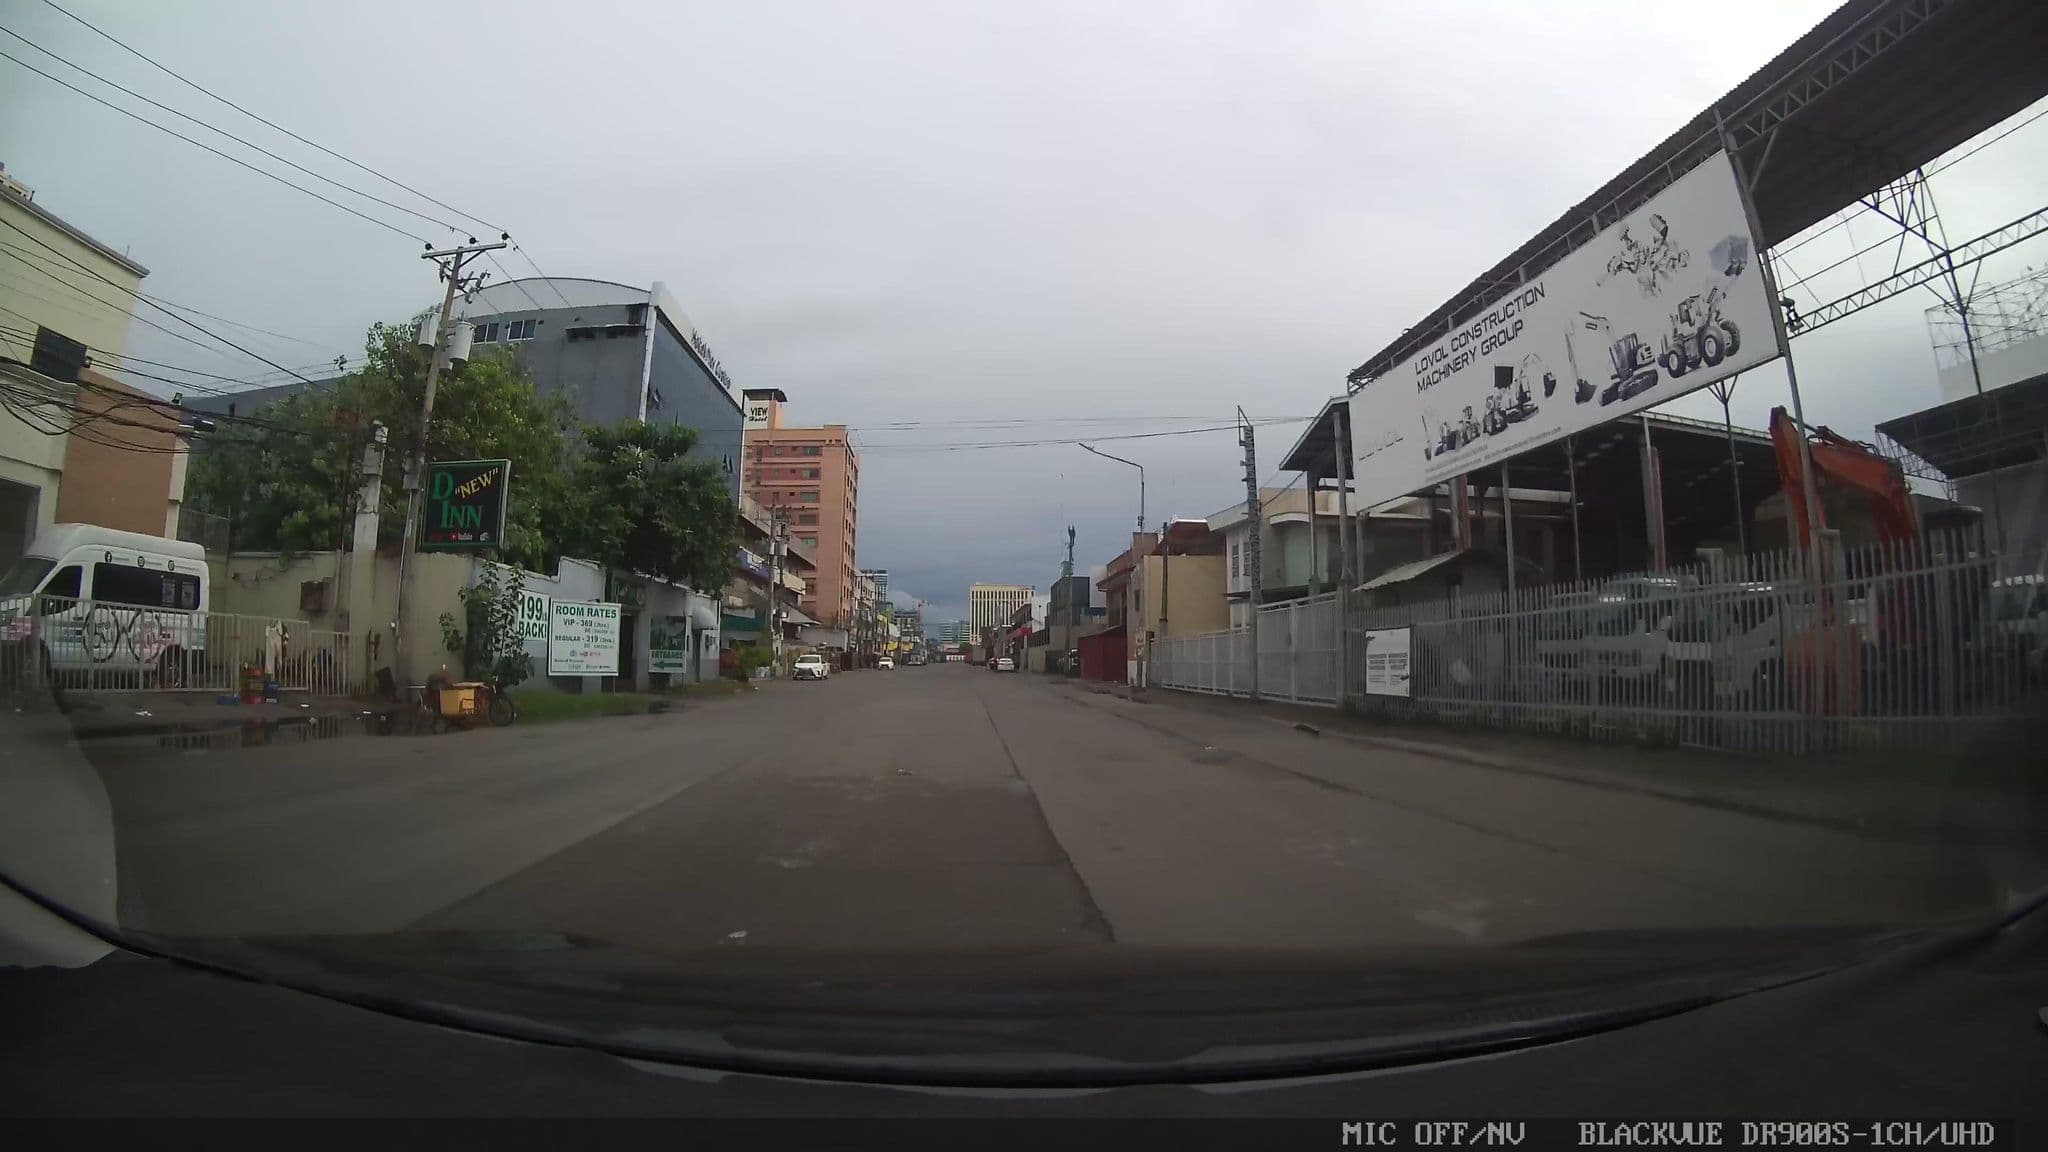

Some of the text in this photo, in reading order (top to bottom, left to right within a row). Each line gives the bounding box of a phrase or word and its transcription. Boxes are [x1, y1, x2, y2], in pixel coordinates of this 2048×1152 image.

[1414, 282, 1546, 375] LOVOL CONSTRUCTION
[1416, 319, 1524, 395] MACHINERY GROUP
[750, 407, 768, 416] VIEW
[431, 471, 454, 500] D
[440, 500, 483, 528] INN
[555, 605, 584, 617] ROOM
[587, 607, 617, 618] RATES
[563, 618, 575, 626] VIP
[518, 621, 547, 639] BACK!
